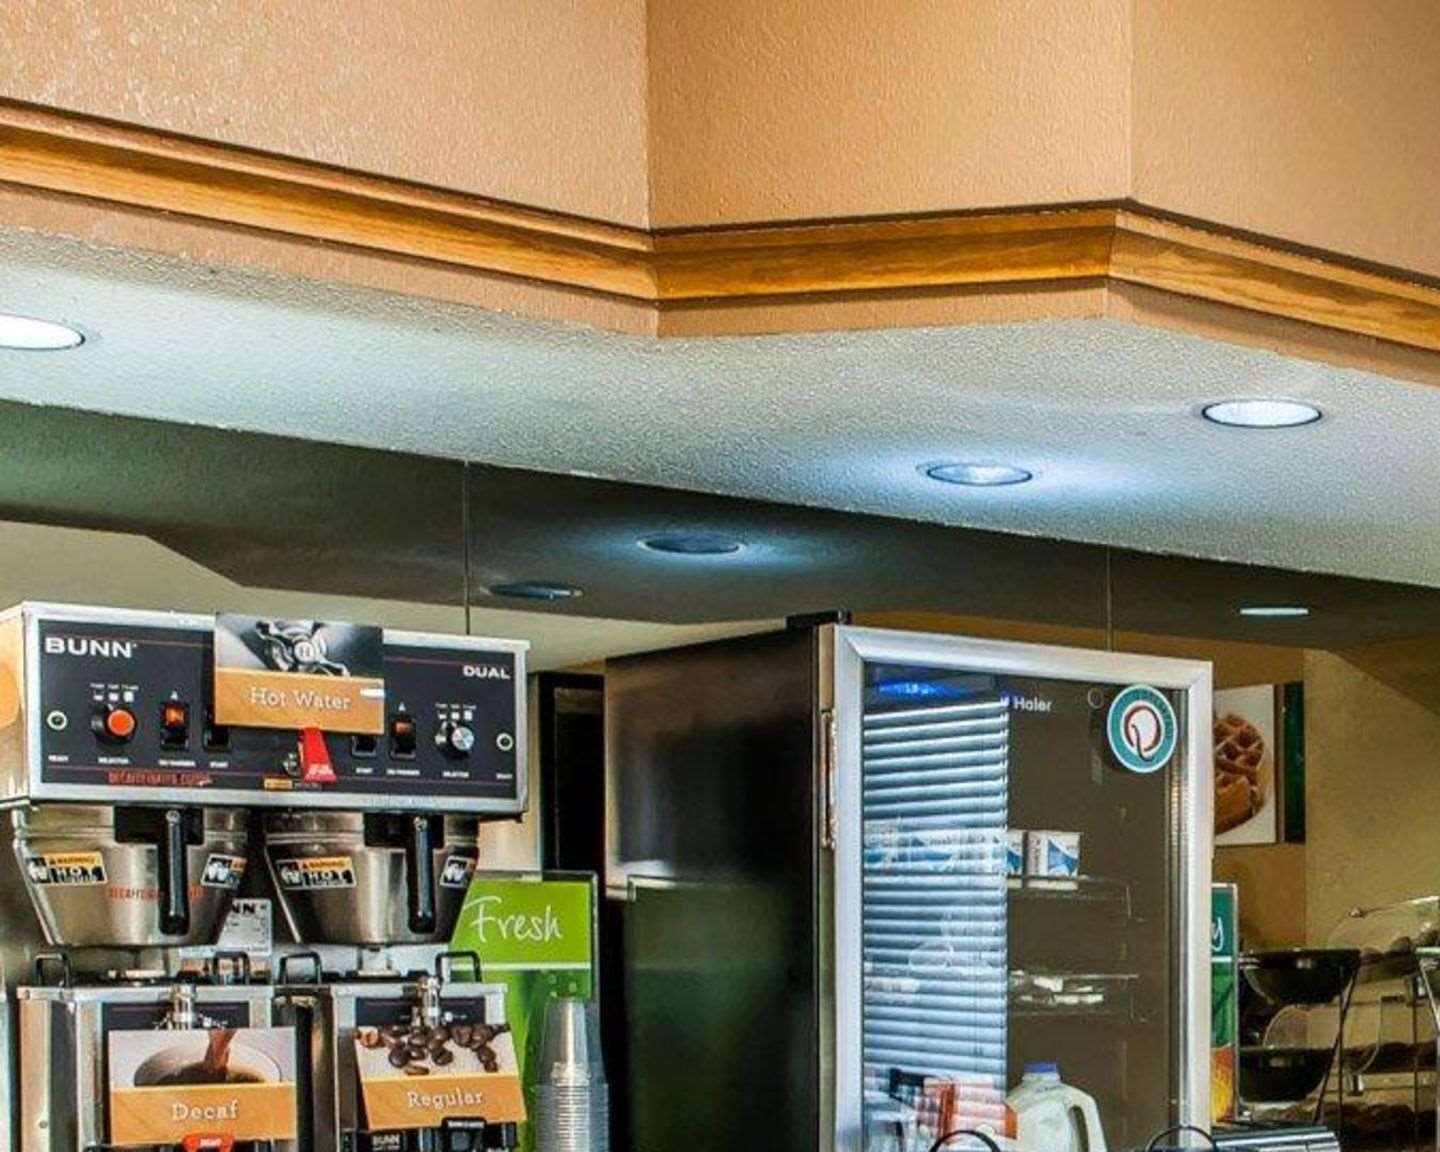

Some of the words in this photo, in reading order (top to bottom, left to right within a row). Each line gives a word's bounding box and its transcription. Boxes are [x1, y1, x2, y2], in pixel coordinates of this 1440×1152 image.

[44, 636, 132, 659] BUNN
[462, 665, 511, 680] DUAL
[250, 686, 287, 708] Hot
[294, 689, 352, 710] Water
[461, 895, 563, 943] Fresh
[171, 1098, 239, 1121] Decaf
[407, 1086, 484, 1111] Regular
